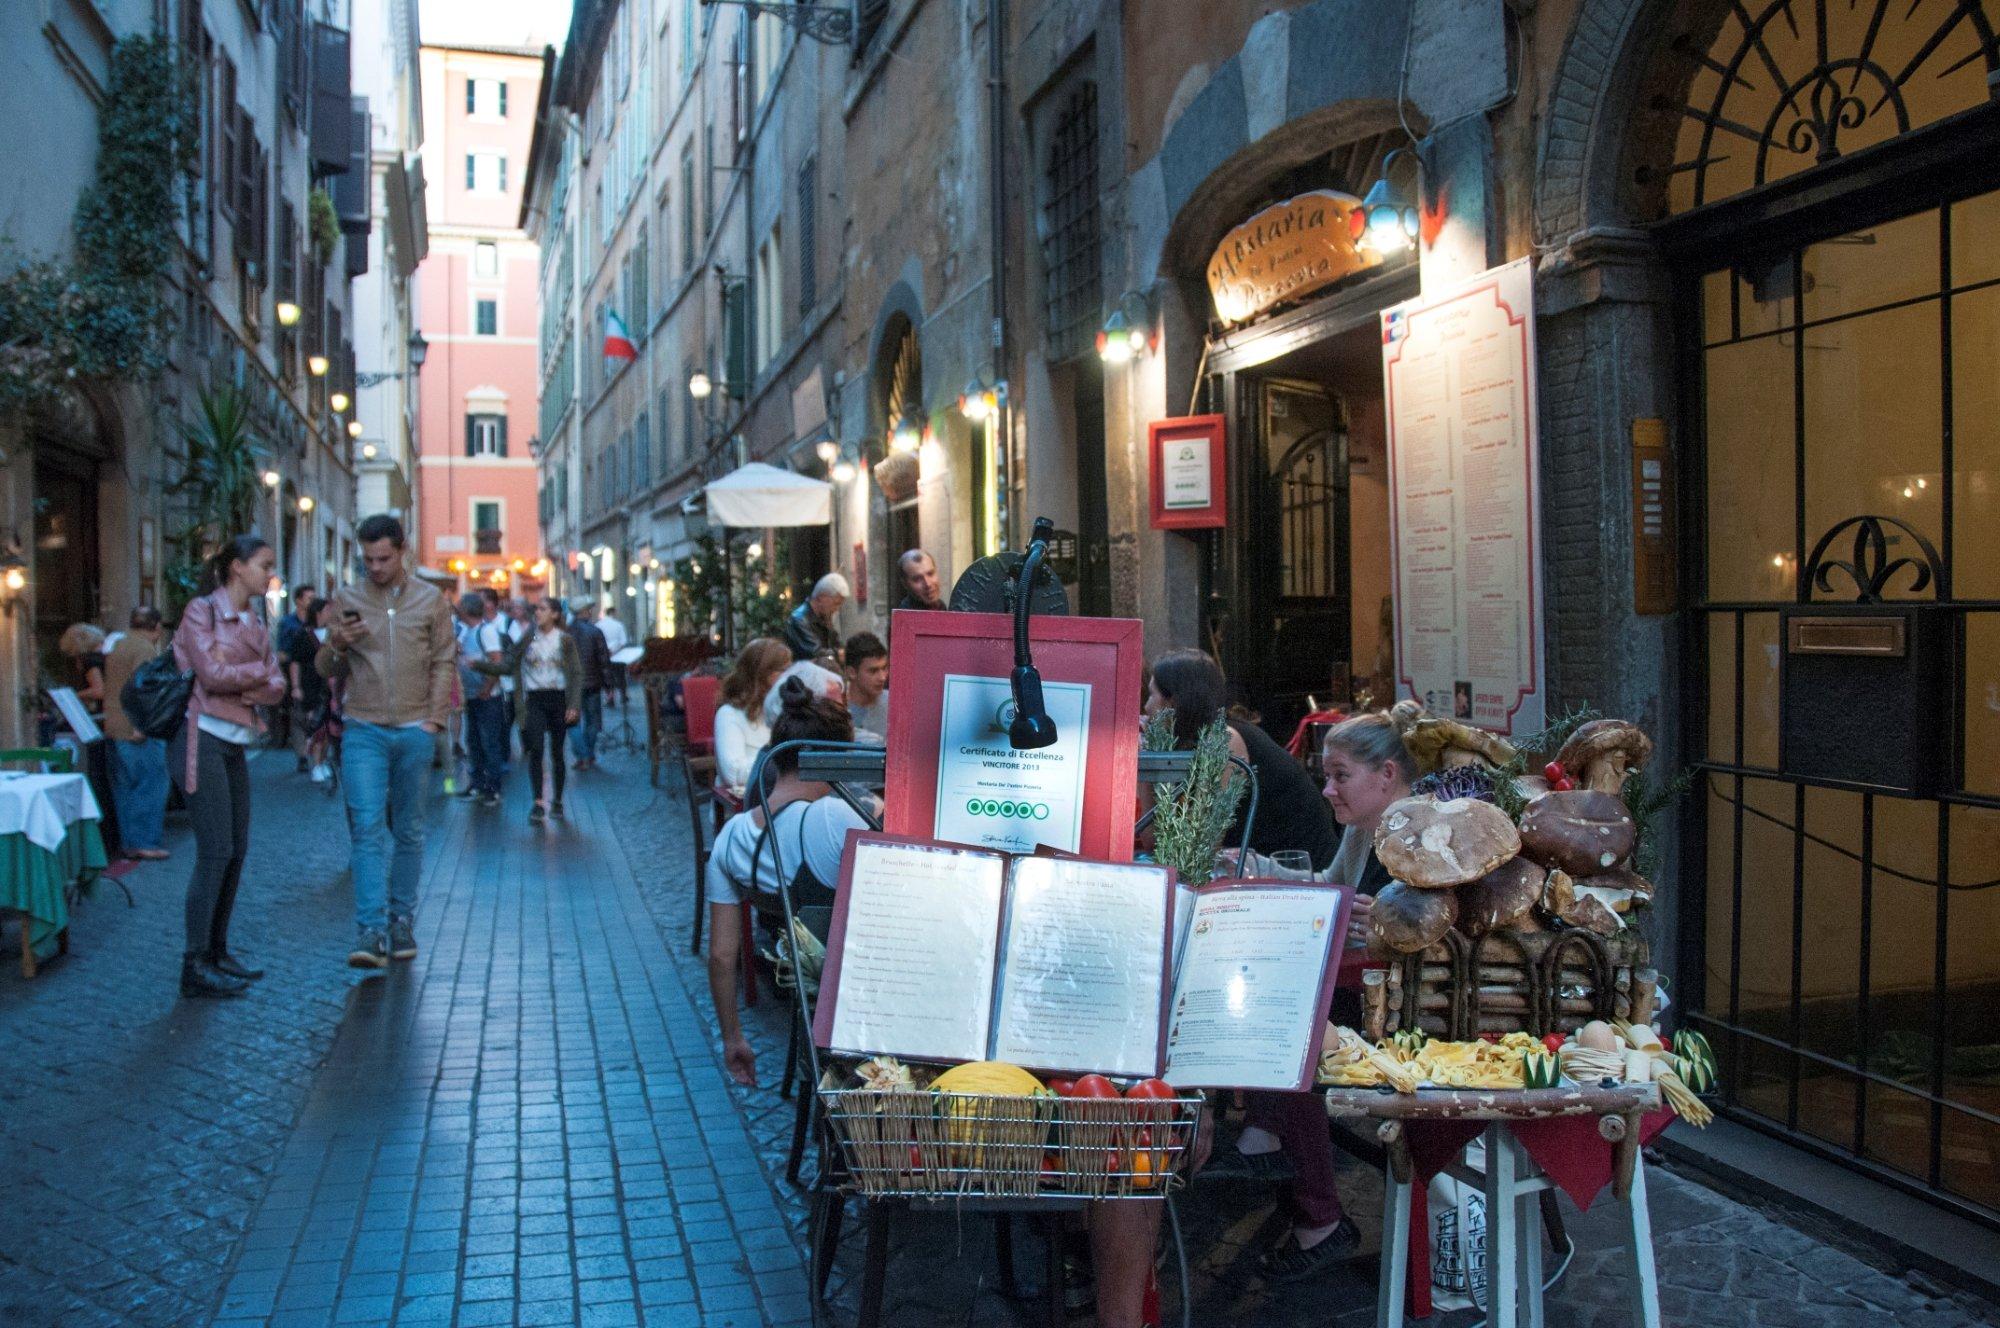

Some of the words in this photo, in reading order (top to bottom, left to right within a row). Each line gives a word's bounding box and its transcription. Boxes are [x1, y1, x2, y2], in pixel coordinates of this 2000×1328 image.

[960, 746, 1006, 758] Certificato
[1008, 750, 1017, 758] di
[1019, 751, 1064, 761] Eccellenza
[982, 761, 1020, 770] VINCITORE
